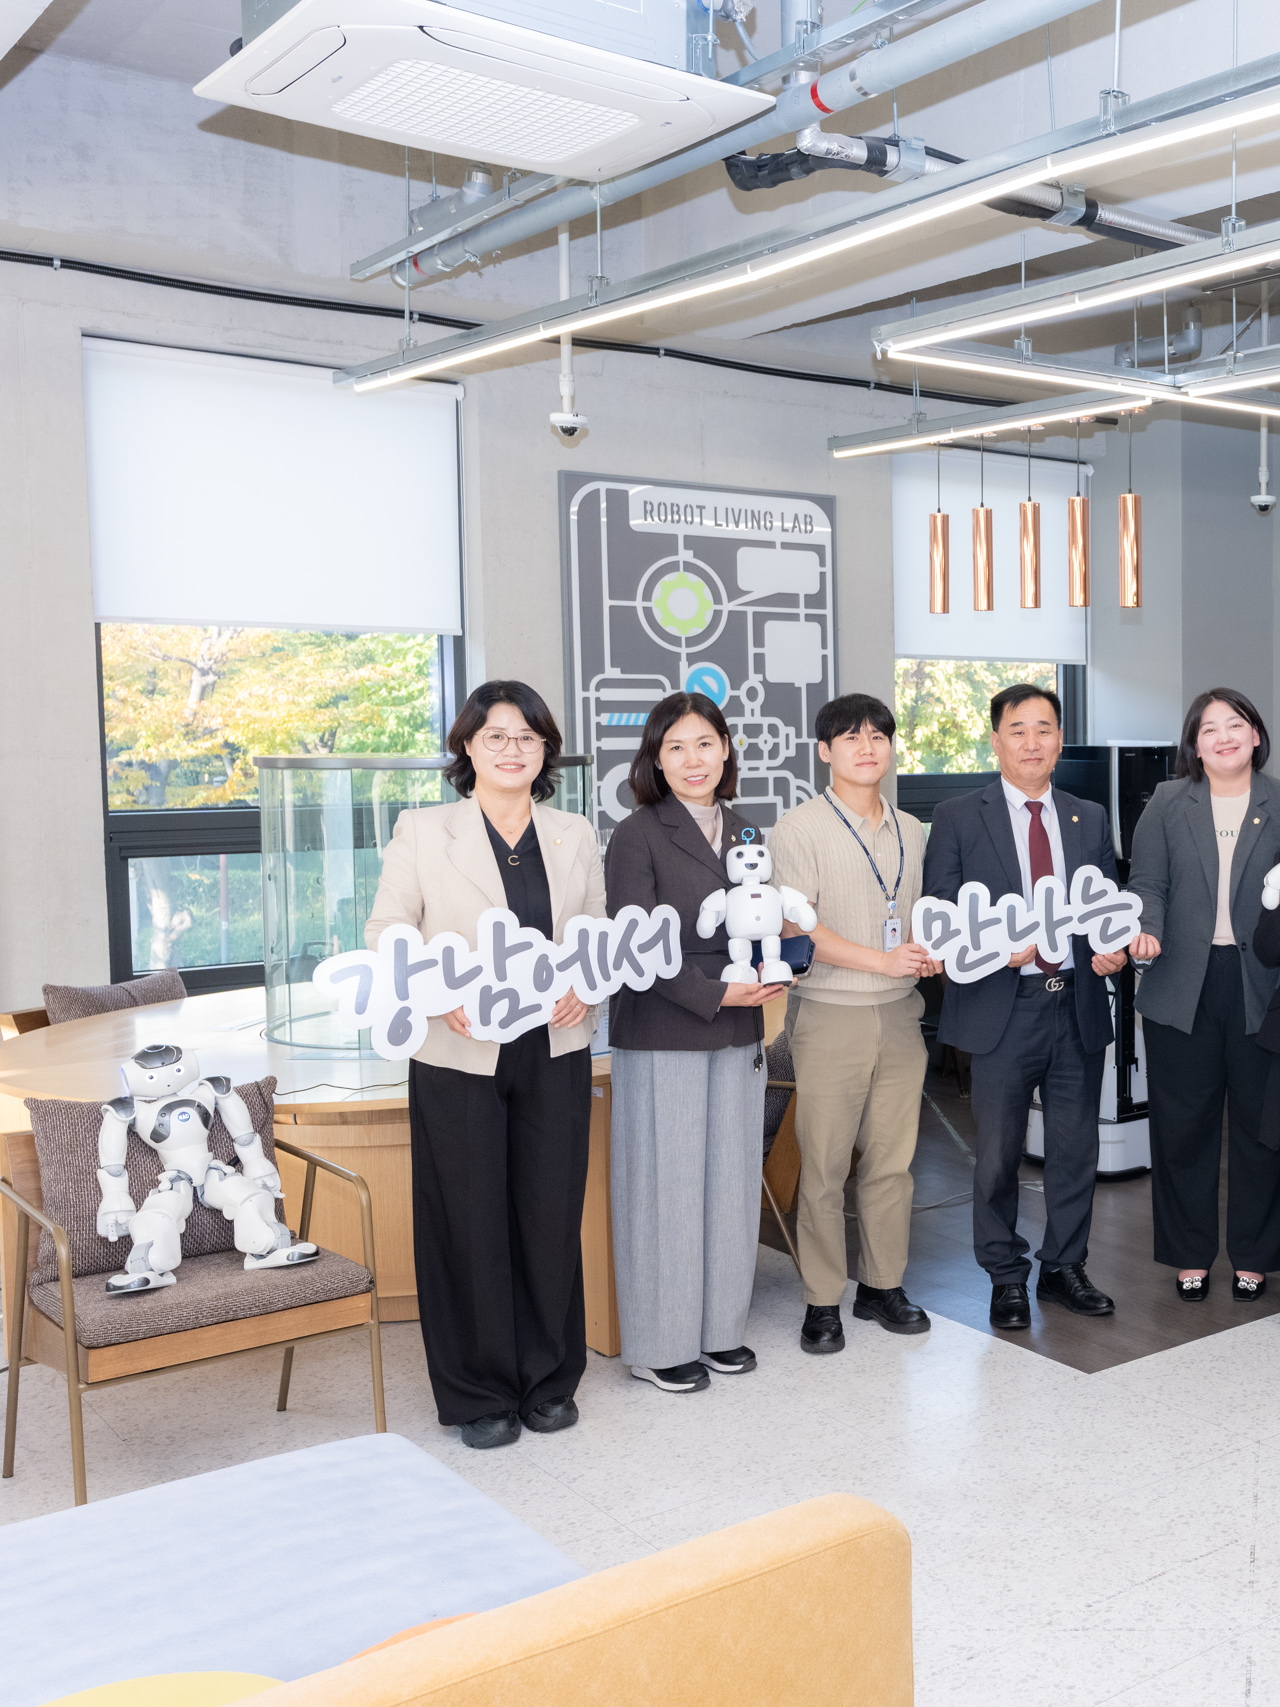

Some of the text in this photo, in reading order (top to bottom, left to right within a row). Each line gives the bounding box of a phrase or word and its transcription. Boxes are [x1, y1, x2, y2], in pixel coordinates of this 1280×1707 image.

[643, 500, 815, 535] ROBOT LIVING LAB
[922, 875, 1133, 973] 만나는
[329, 917, 672, 1047] 강남에서
